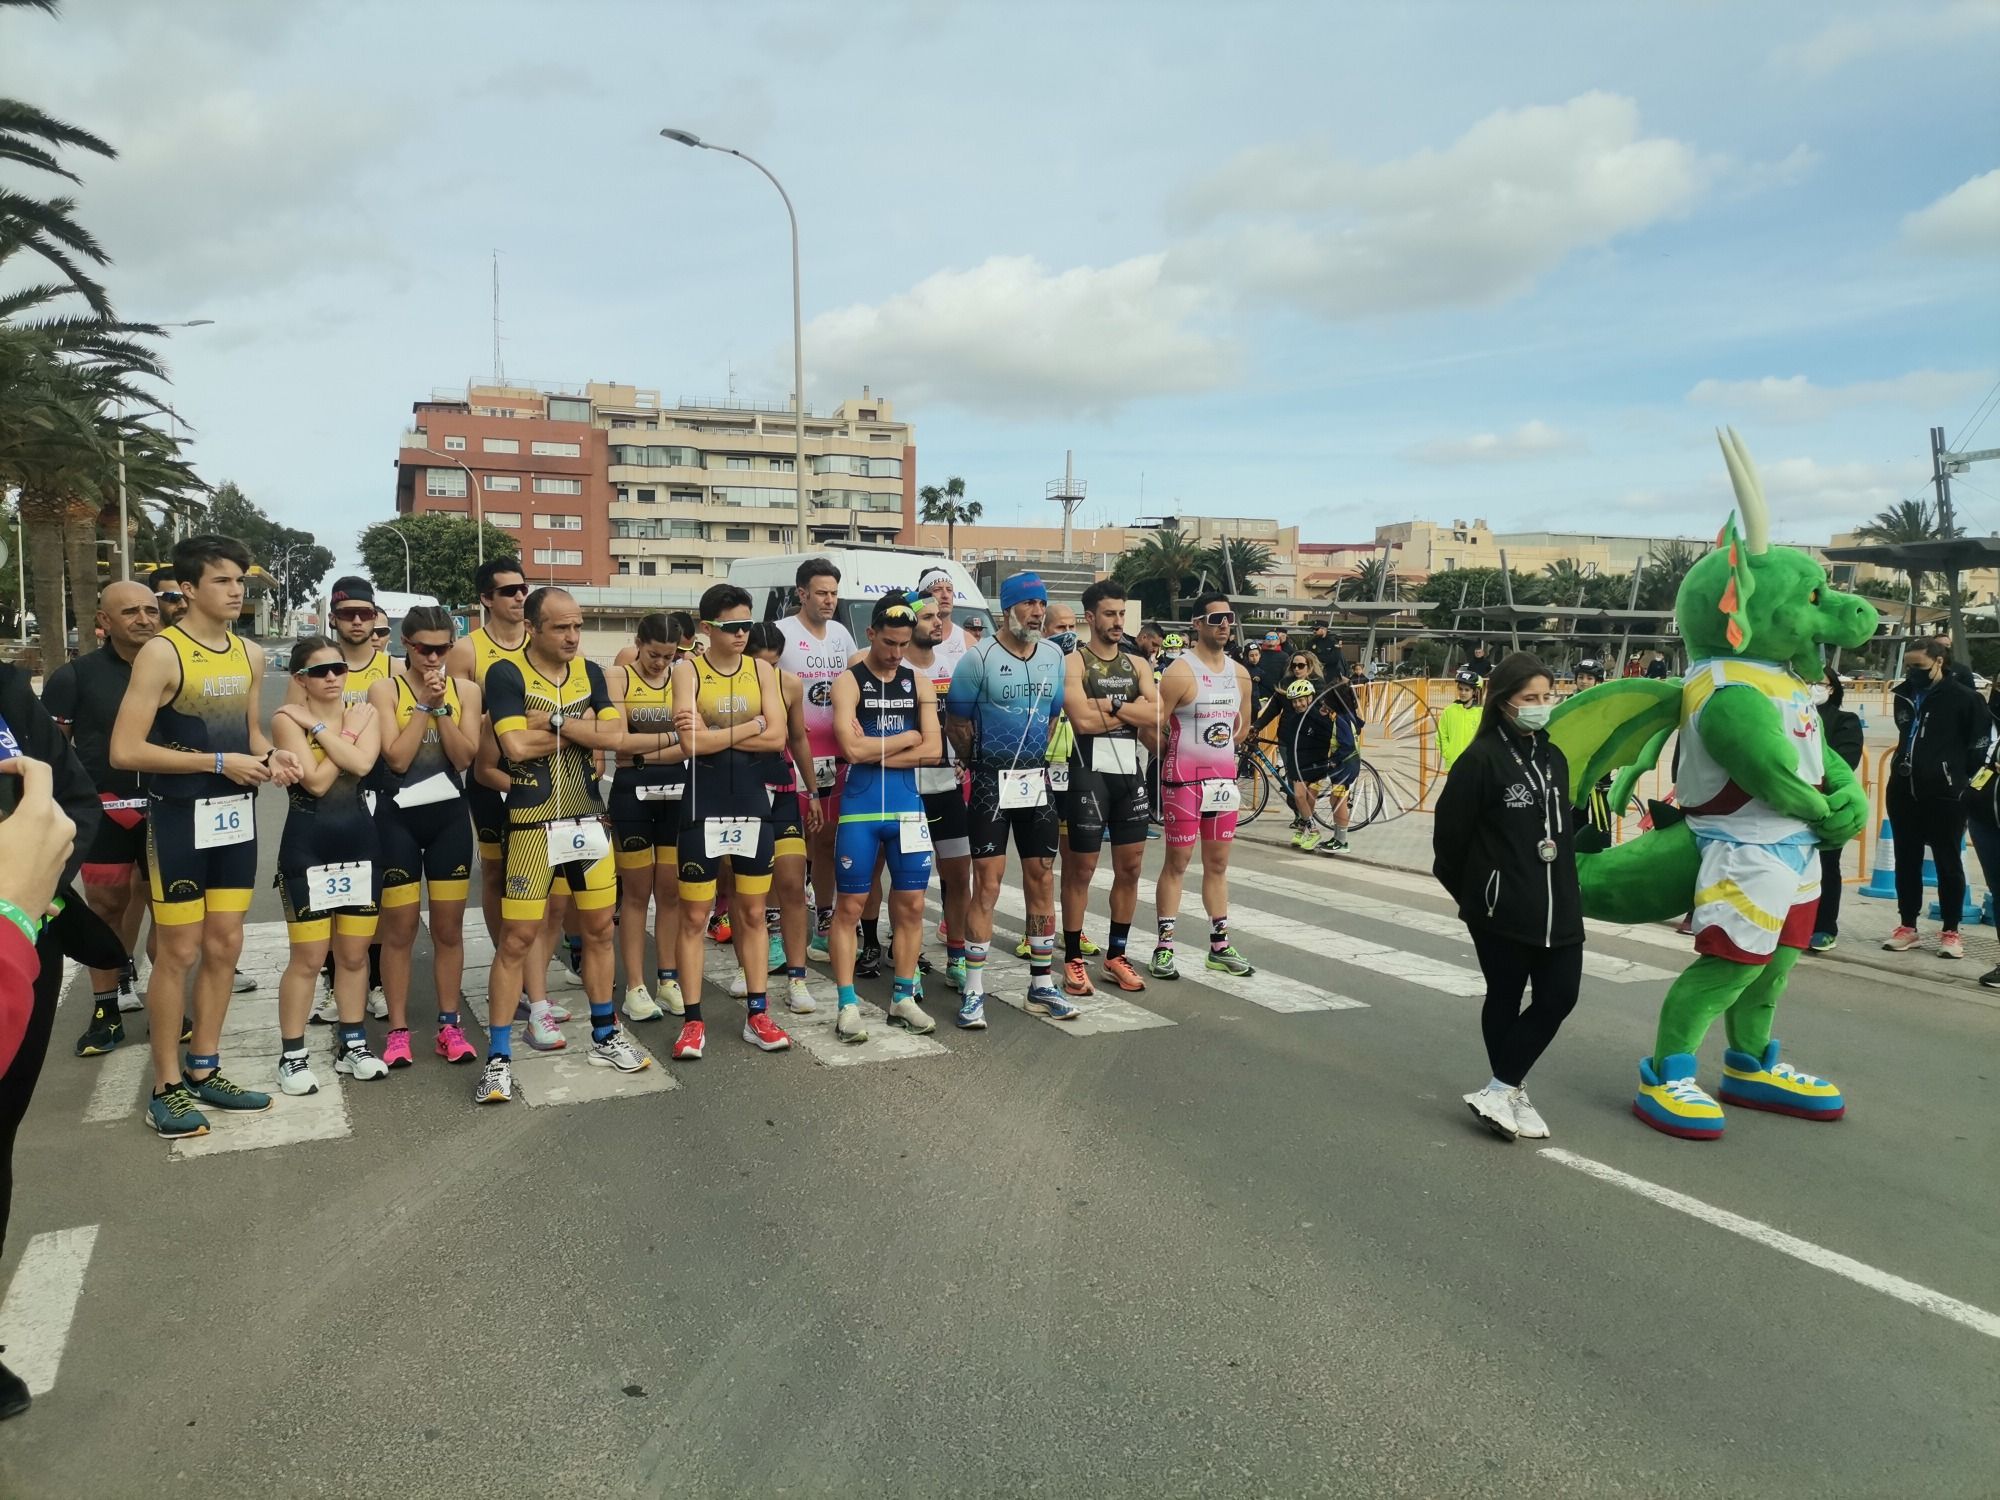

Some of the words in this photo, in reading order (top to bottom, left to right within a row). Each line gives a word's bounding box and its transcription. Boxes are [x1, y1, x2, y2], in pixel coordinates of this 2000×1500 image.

[1002, 683, 1053, 699] GUTIERREZ
[631, 705, 674, 722] GONZÁL
[1052, 770, 1069, 782] 20
[1020, 782, 1029, 796] 3
[1213, 790, 1230, 802] 10
[214, 810, 240, 832] 16
[719, 829, 742, 844] 13
[920, 825, 929, 839] 8
[572, 833, 585, 849] 6
[326, 876, 352, 895] 33
